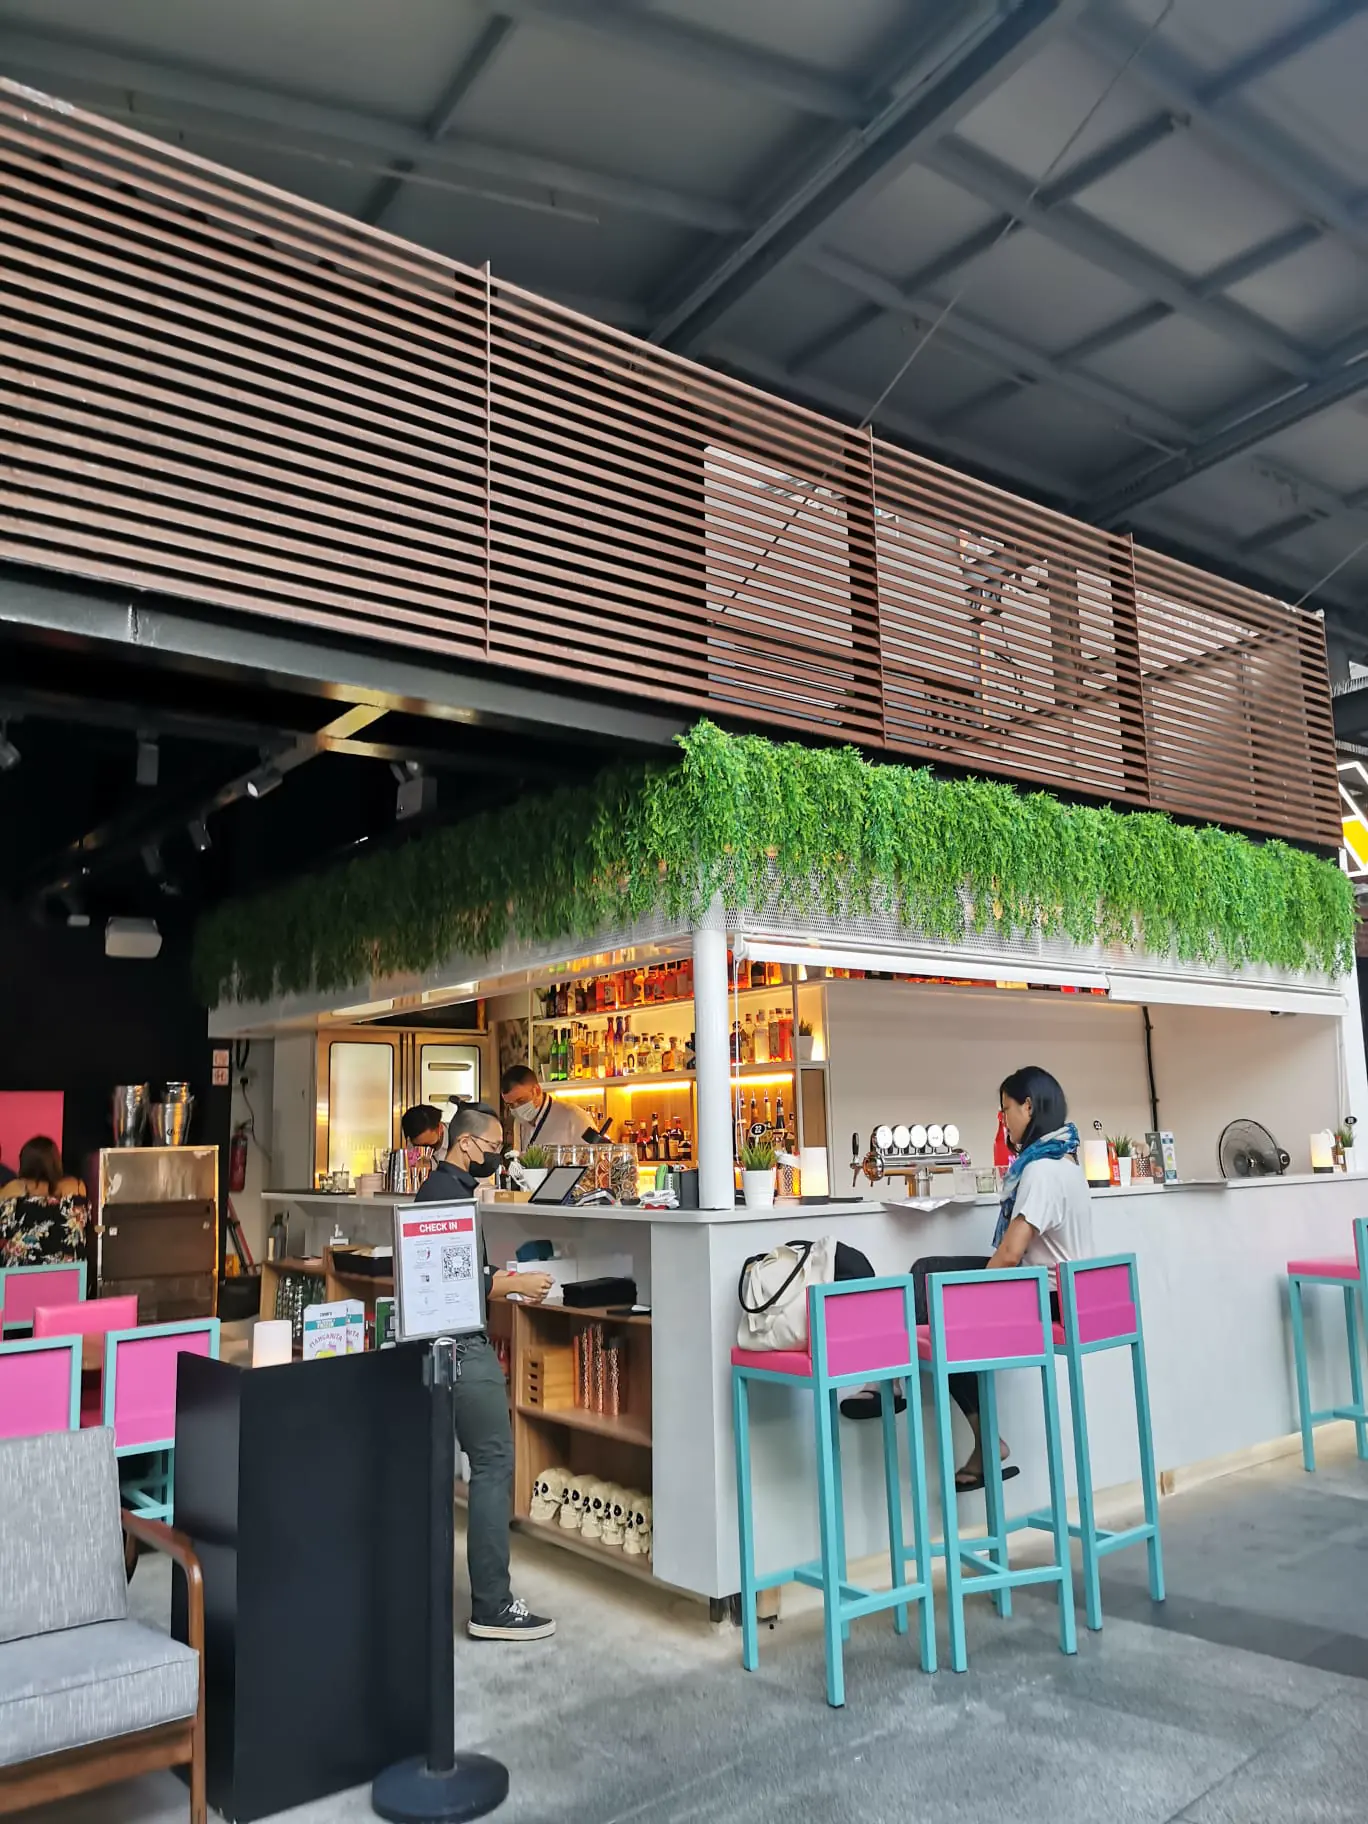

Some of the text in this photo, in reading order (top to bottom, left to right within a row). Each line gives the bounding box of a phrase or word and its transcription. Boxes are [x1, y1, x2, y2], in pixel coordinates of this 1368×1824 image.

[754, 1125, 762, 1134] 22
[419, 1221, 458, 1233] CHECK IN
